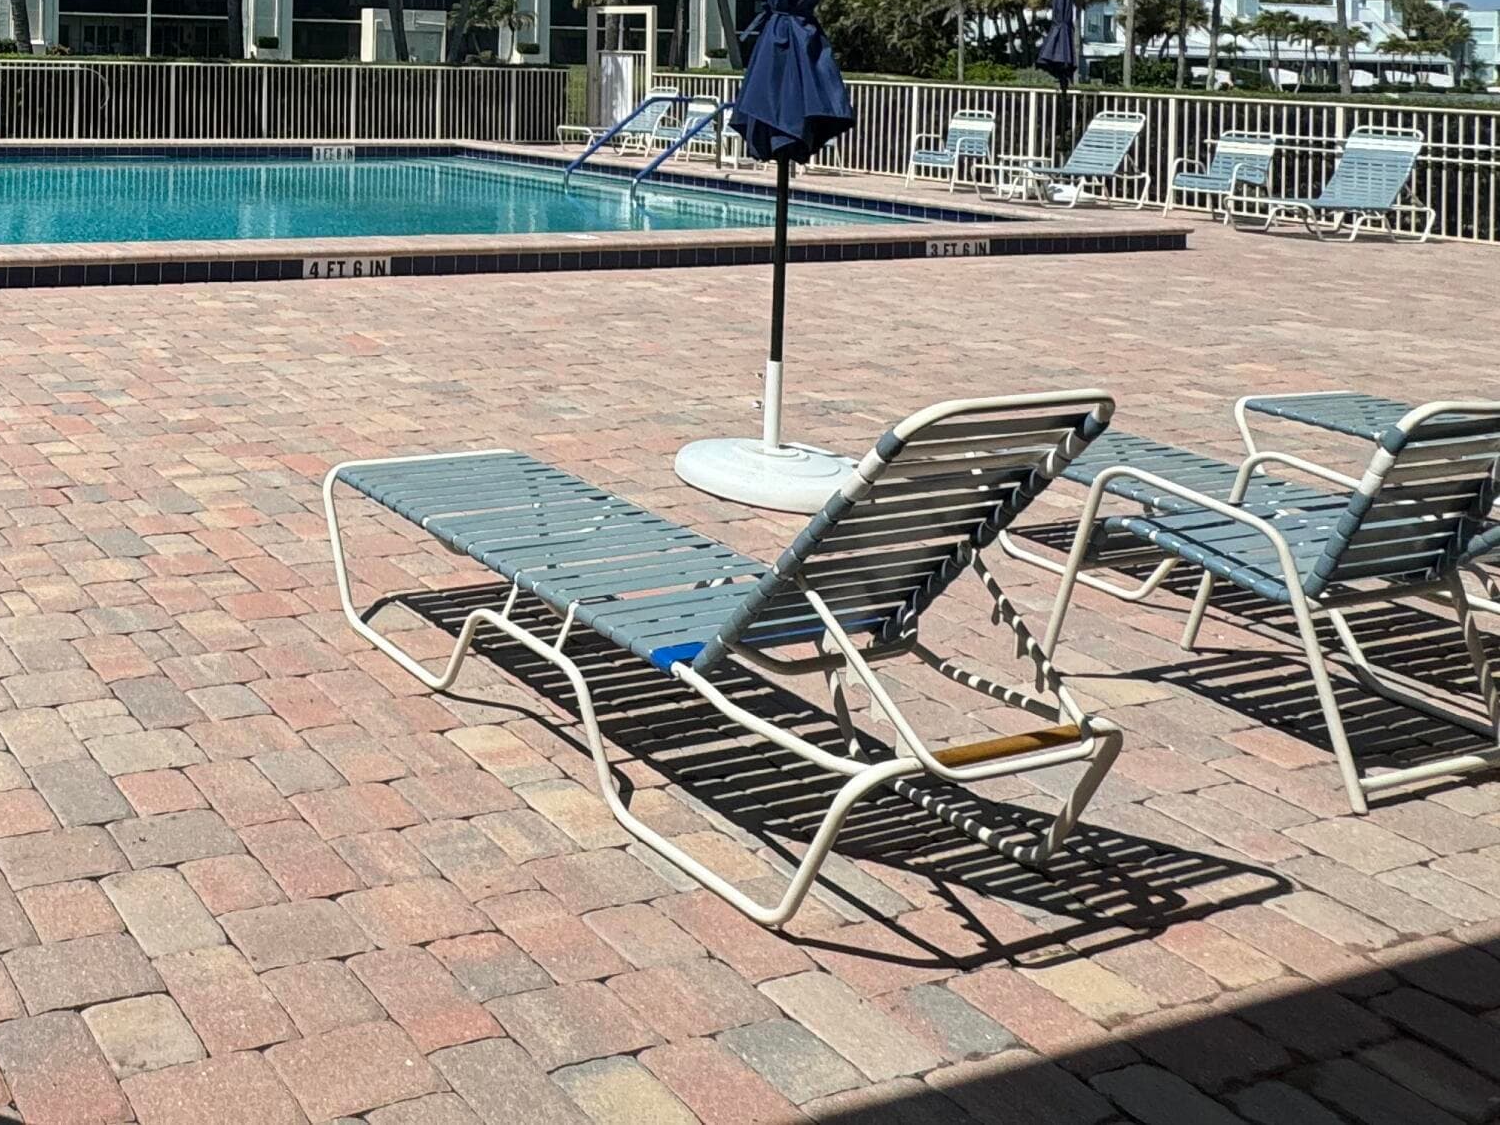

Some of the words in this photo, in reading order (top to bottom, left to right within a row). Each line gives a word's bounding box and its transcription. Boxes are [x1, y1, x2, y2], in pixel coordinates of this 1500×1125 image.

[931, 243, 938, 256] 3
[943, 242, 958, 256] FT
[962, 242, 970, 256] 6
[974, 241, 987, 255] IN
[309, 261, 319, 278] 4
[327, 261, 346, 277] FT
[353, 260, 363, 277] 6
